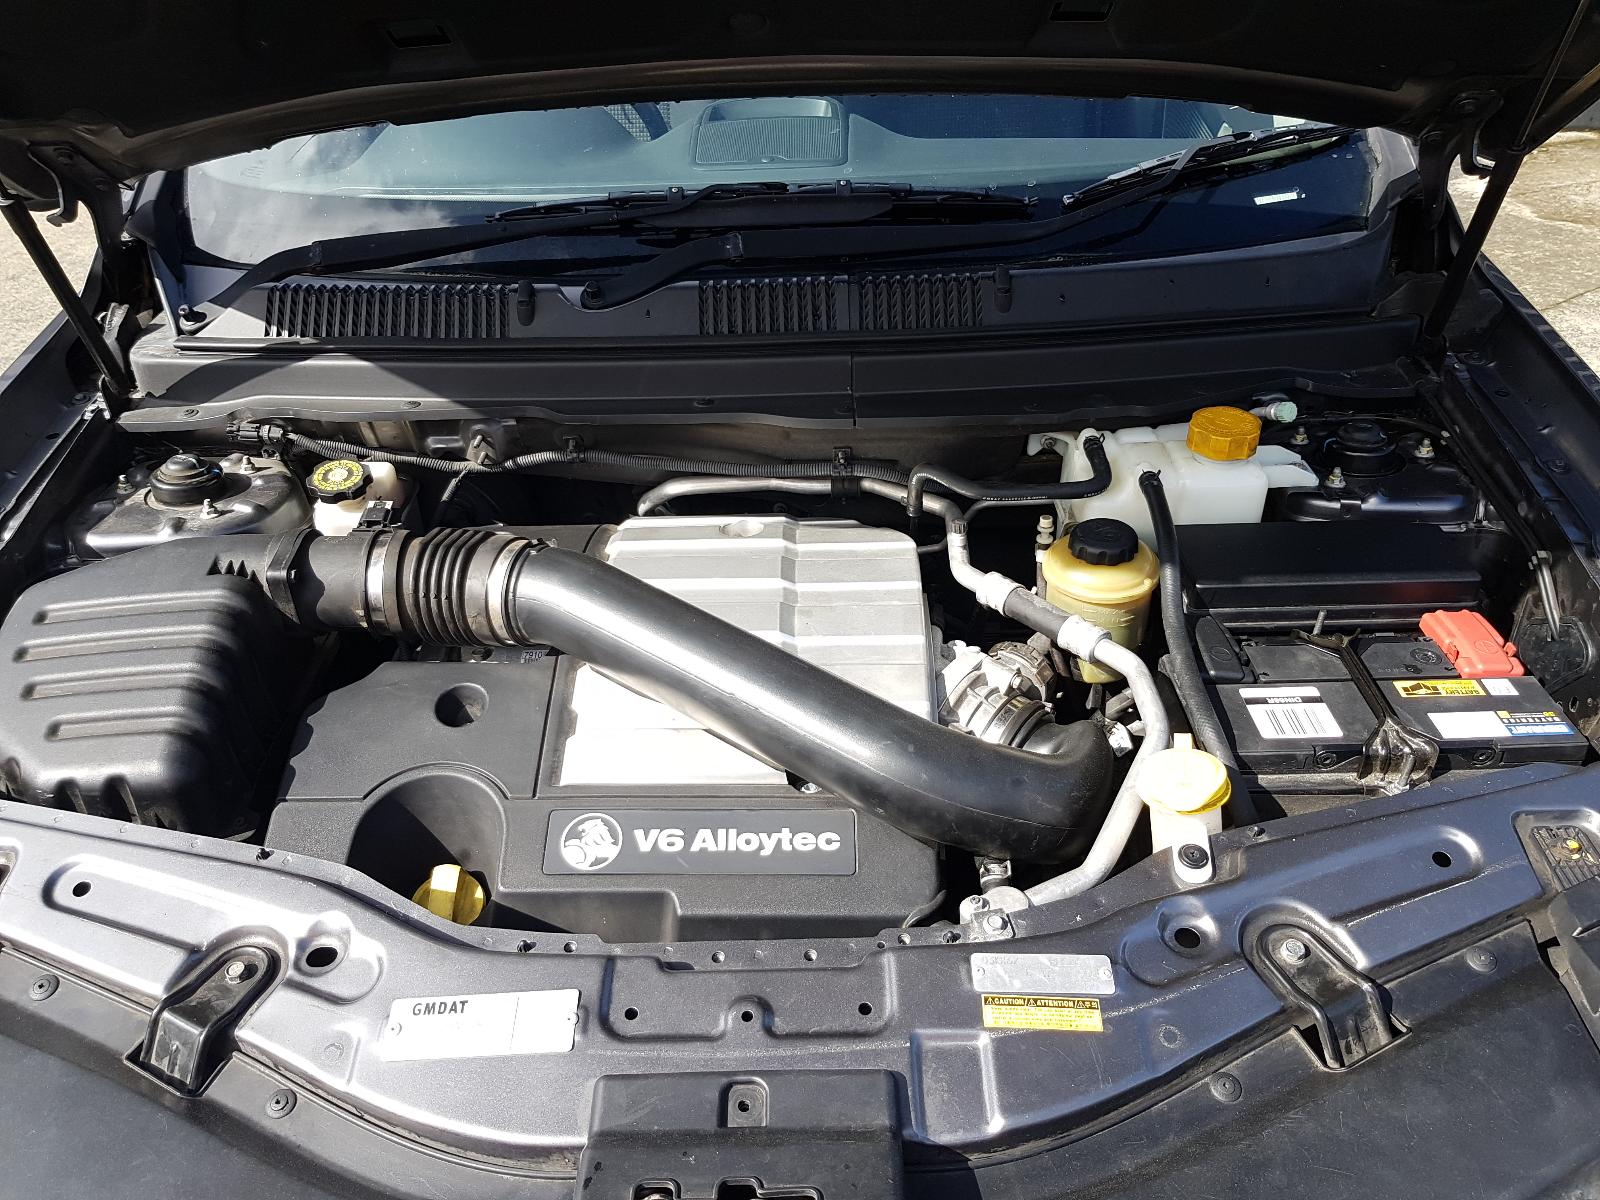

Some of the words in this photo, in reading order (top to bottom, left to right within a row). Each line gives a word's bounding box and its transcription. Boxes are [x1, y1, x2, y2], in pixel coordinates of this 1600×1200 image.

[524, 651, 543, 659] 7910
[633, 828, 685, 852] V6
[690, 827, 841, 856] Alloytec
[994, 997, 1025, 1006] CAUTION
[1036, 1000, 1074, 1008] ATTENTION
[412, 1000, 469, 1016] GMDAT
